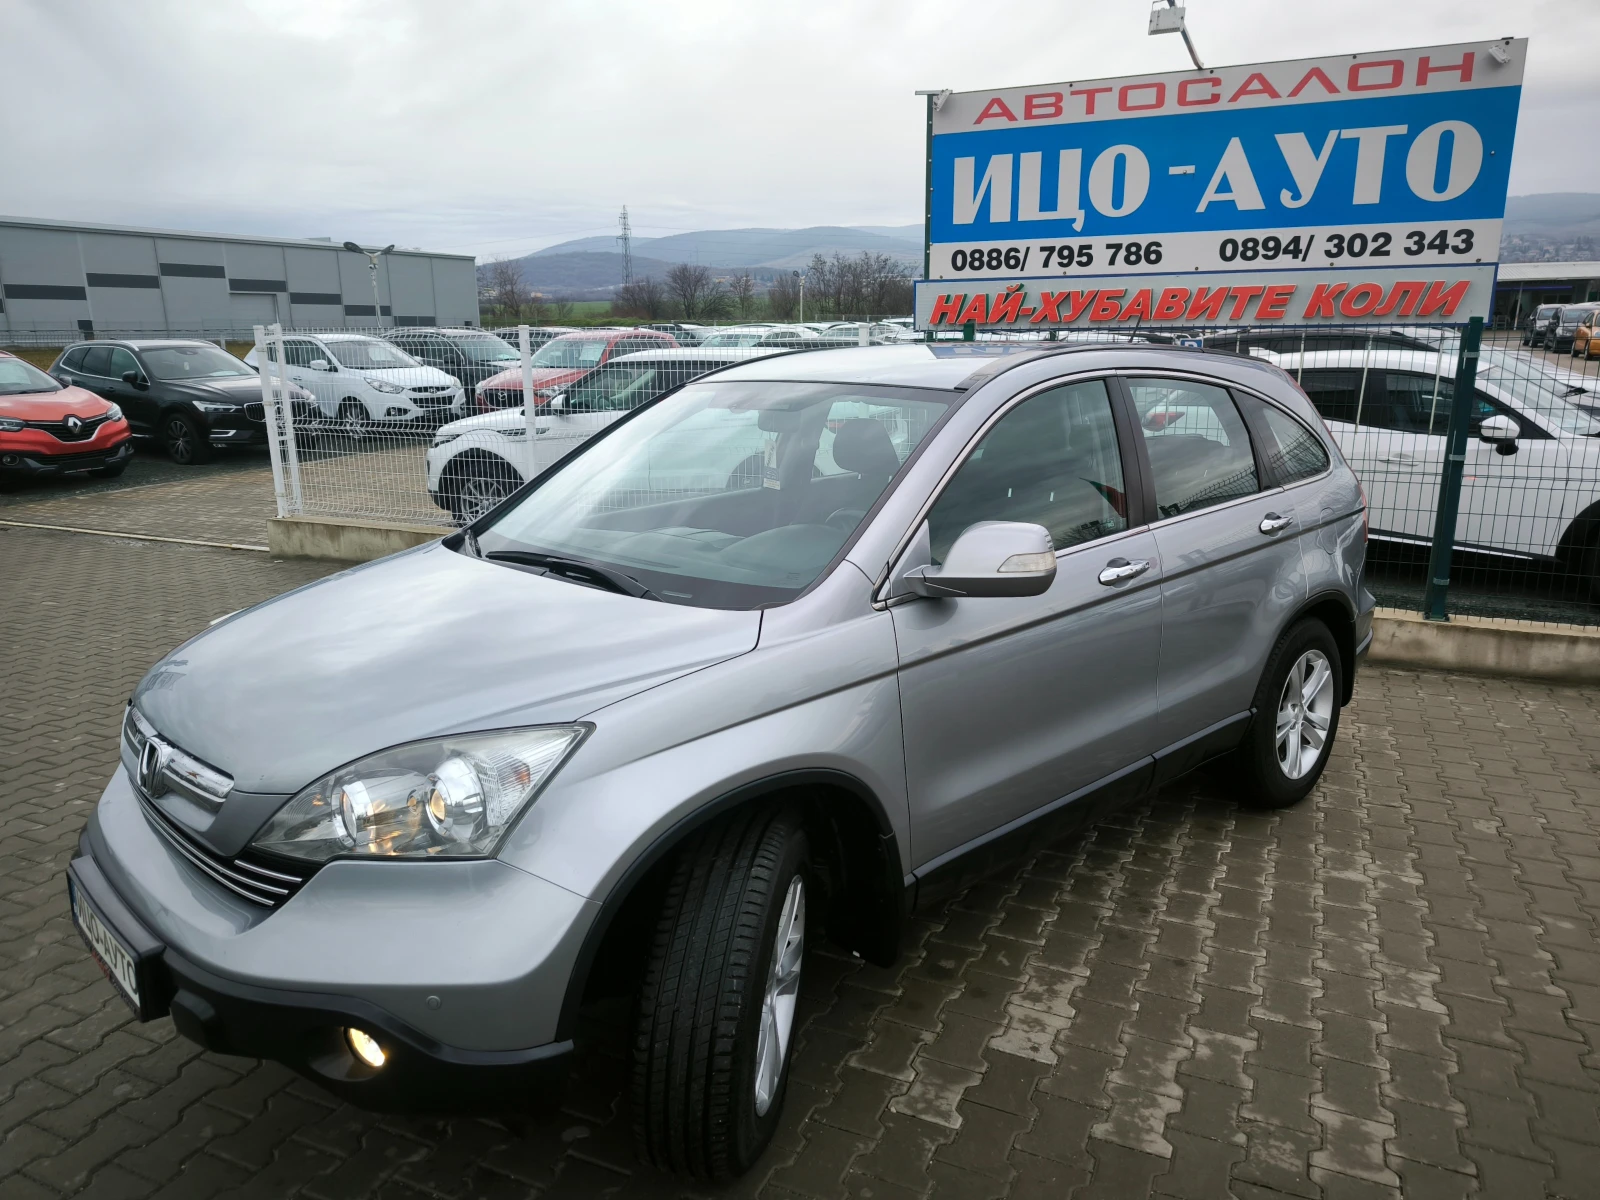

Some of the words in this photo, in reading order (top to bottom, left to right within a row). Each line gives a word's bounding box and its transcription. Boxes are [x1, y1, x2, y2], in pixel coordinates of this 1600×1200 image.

[973, 52, 1475, 124] АВТОСАЛОН
[951, 246, 1030, 271] 0886/
[1039, 244, 1093, 268] 795
[1105, 241, 1163, 266] 786
[1219, 234, 1315, 263] 0894/
[1324, 231, 1393, 258] 302
[1403, 228, 1475, 256] 343
[928, 283, 1297, 325] НАЙ-ХУБАВИТЕ
[1302, 279, 1471, 318] КОЛИ
